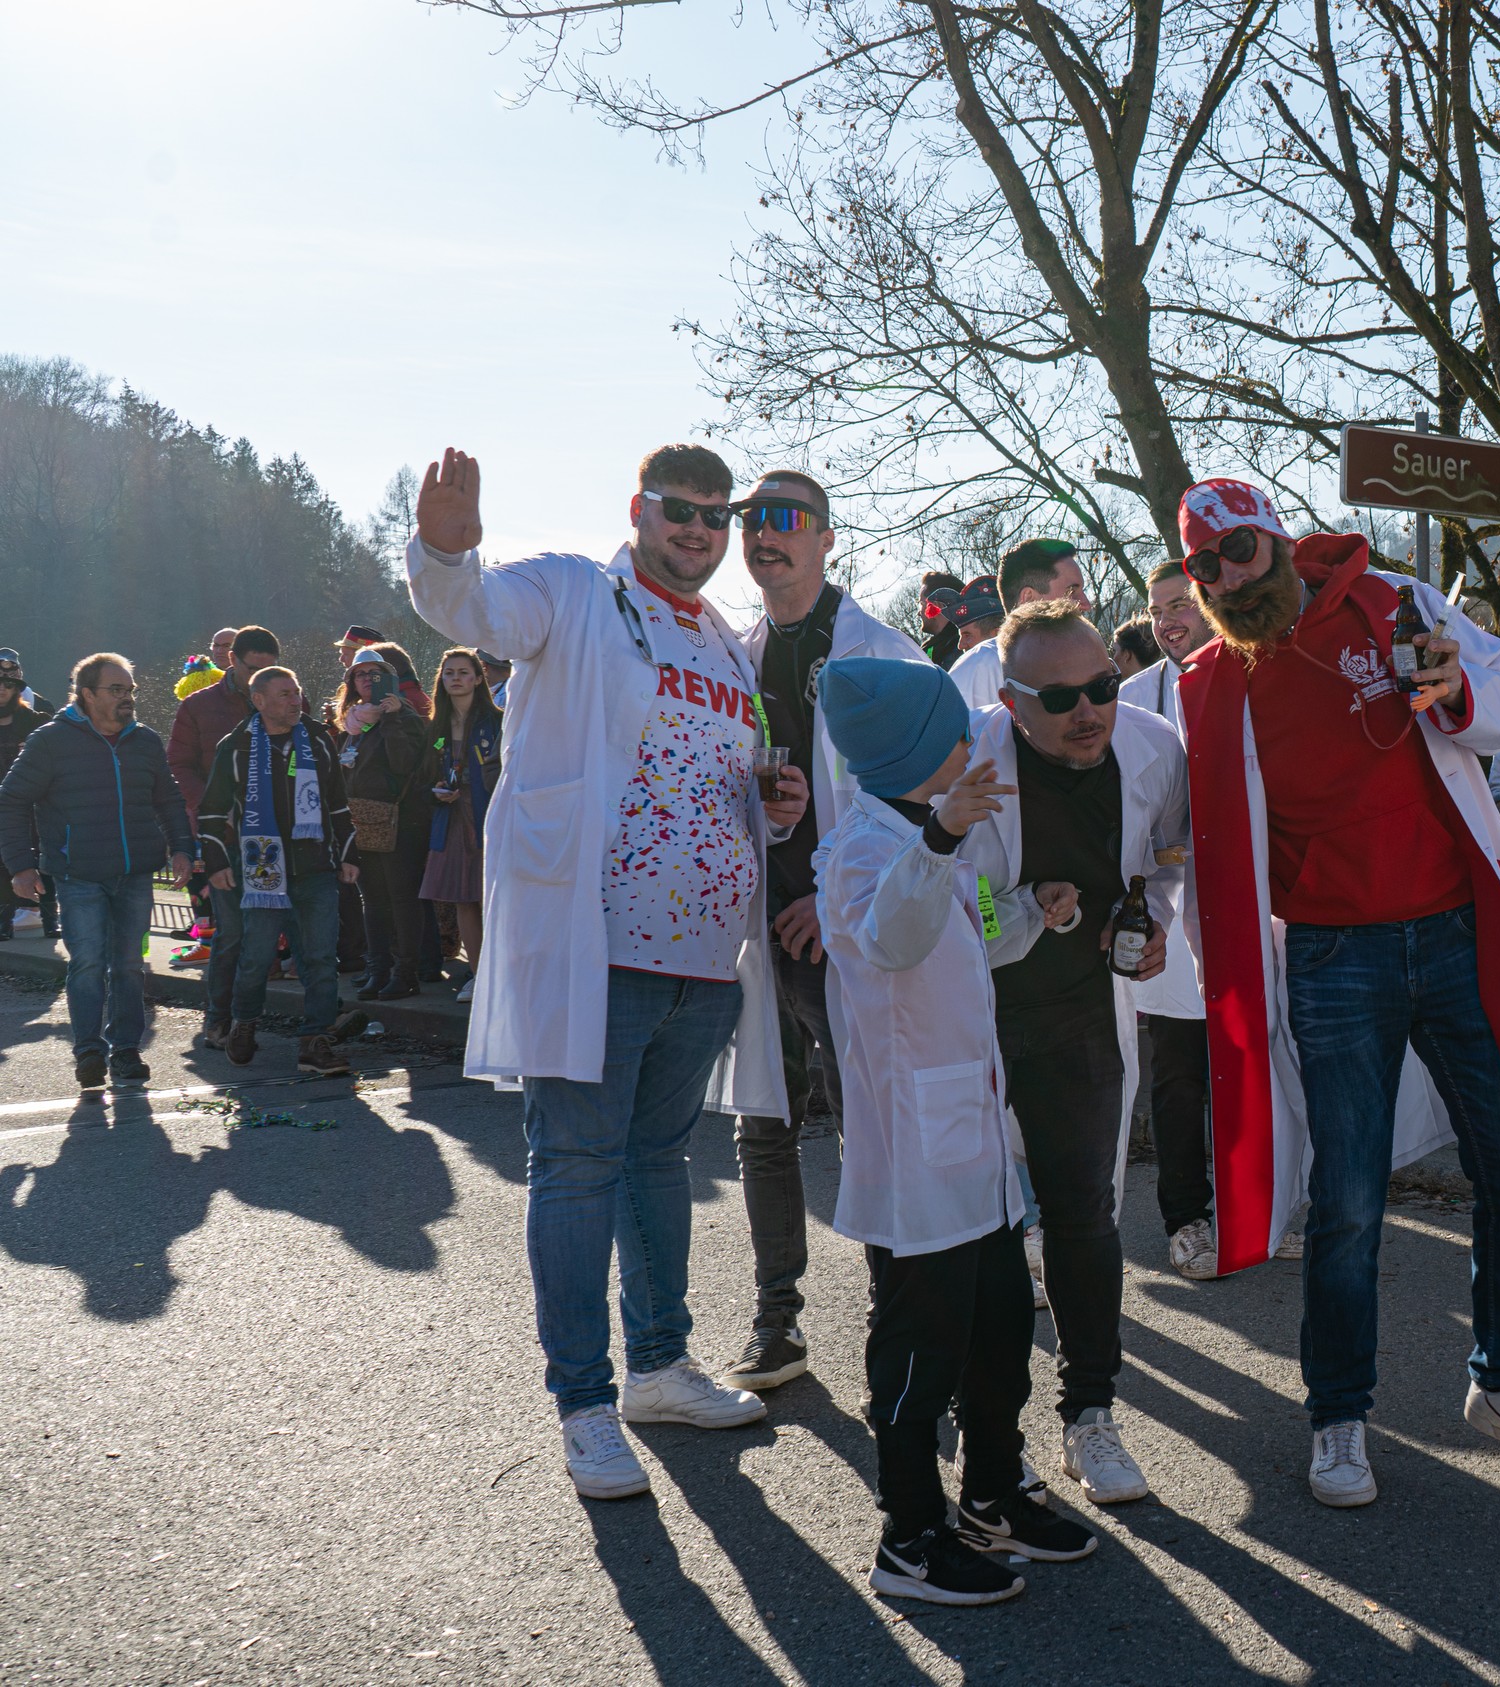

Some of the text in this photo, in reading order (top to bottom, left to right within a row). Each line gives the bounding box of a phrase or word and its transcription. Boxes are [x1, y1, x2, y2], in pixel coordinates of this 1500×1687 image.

[1392, 442, 1471, 481] Sauer
[656, 666, 757, 731] REWE
[245, 810, 260, 827] KV
